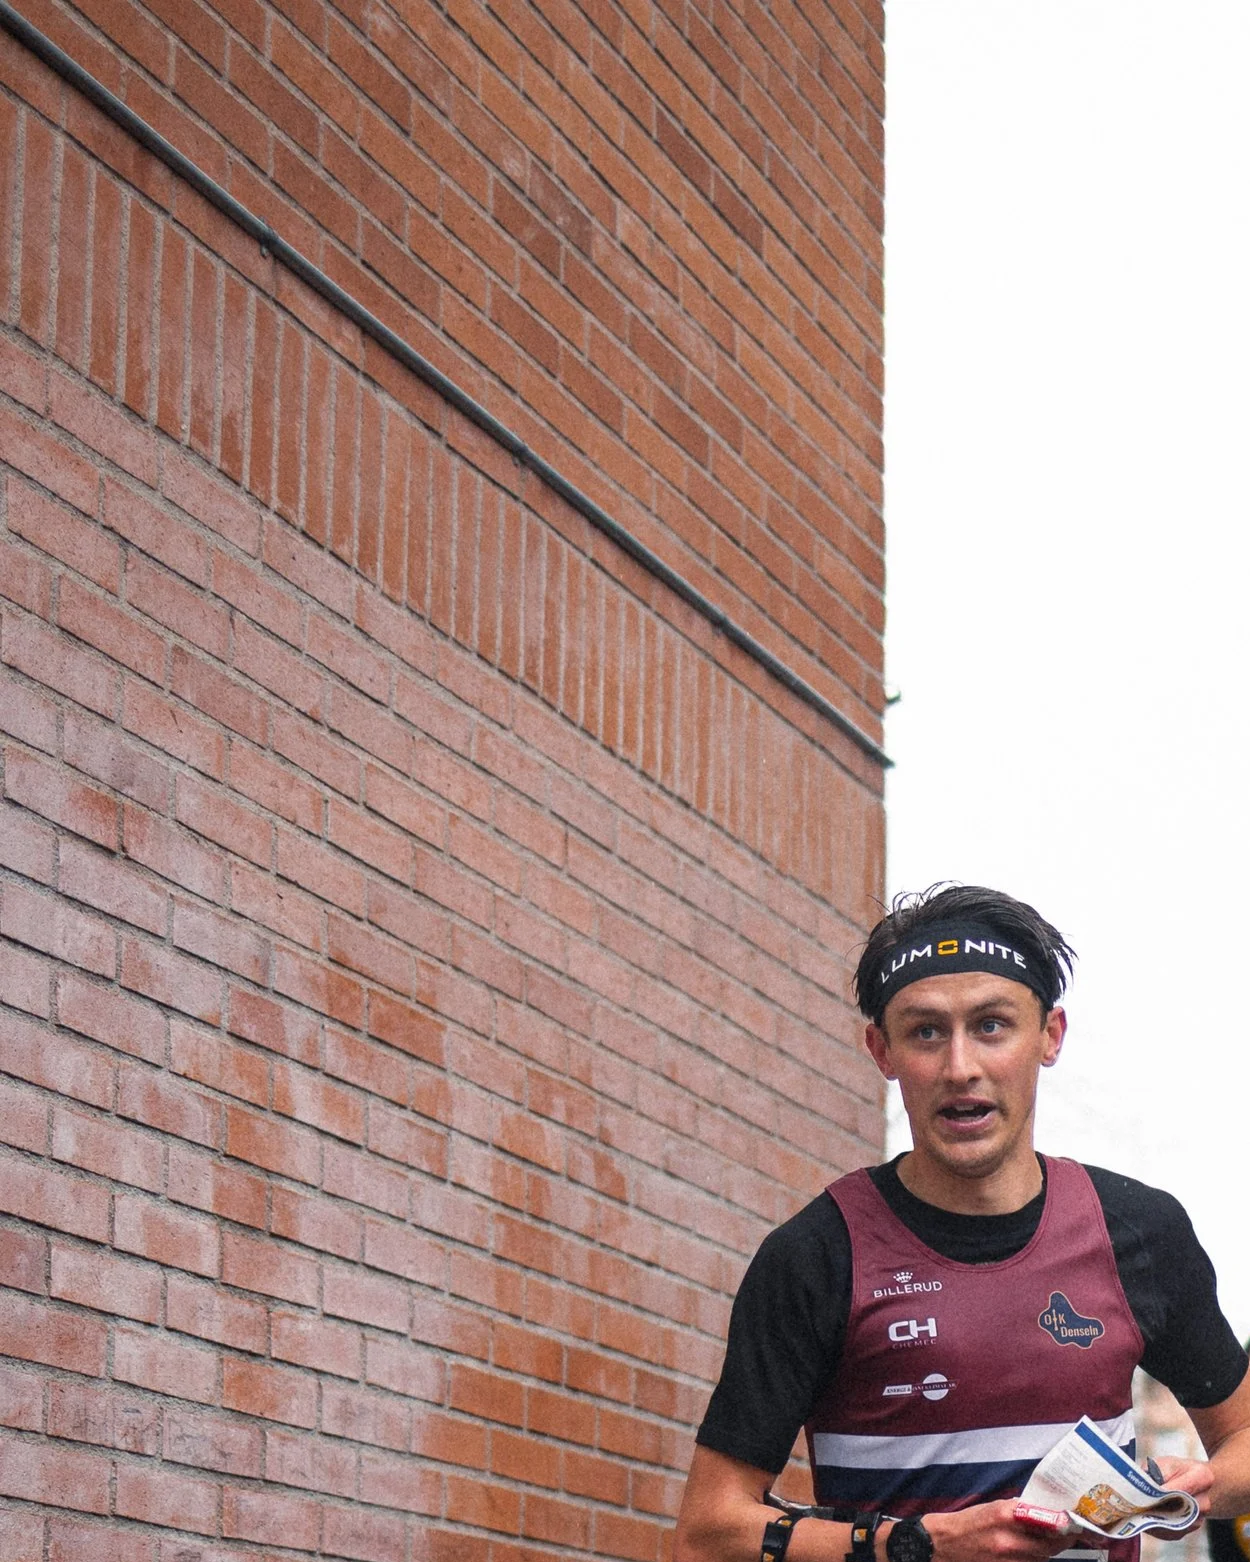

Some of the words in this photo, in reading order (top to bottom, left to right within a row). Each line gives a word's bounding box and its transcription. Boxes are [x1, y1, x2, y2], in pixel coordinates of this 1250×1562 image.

[881, 939, 1027, 984] LUMONITE
[873, 1280, 943, 1298] BILLERUD
[888, 1317, 938, 1341] CH
